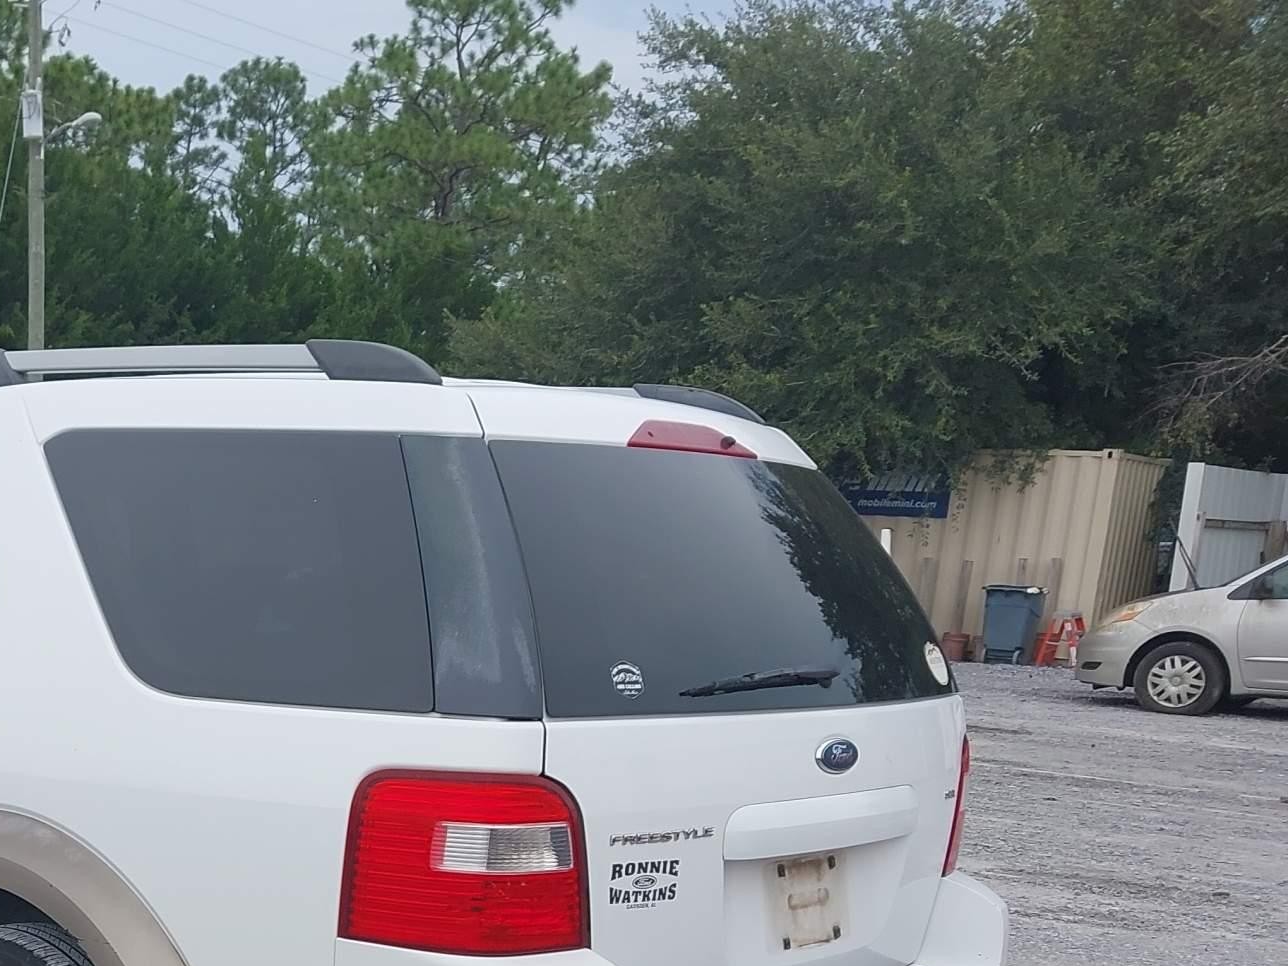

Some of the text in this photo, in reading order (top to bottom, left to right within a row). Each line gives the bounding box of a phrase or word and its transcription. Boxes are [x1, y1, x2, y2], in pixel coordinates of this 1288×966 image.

[610, 826, 715, 847] FREESTYLE
[610, 859, 680, 881] RONNIE
[609, 883, 677, 905] WATKINS
